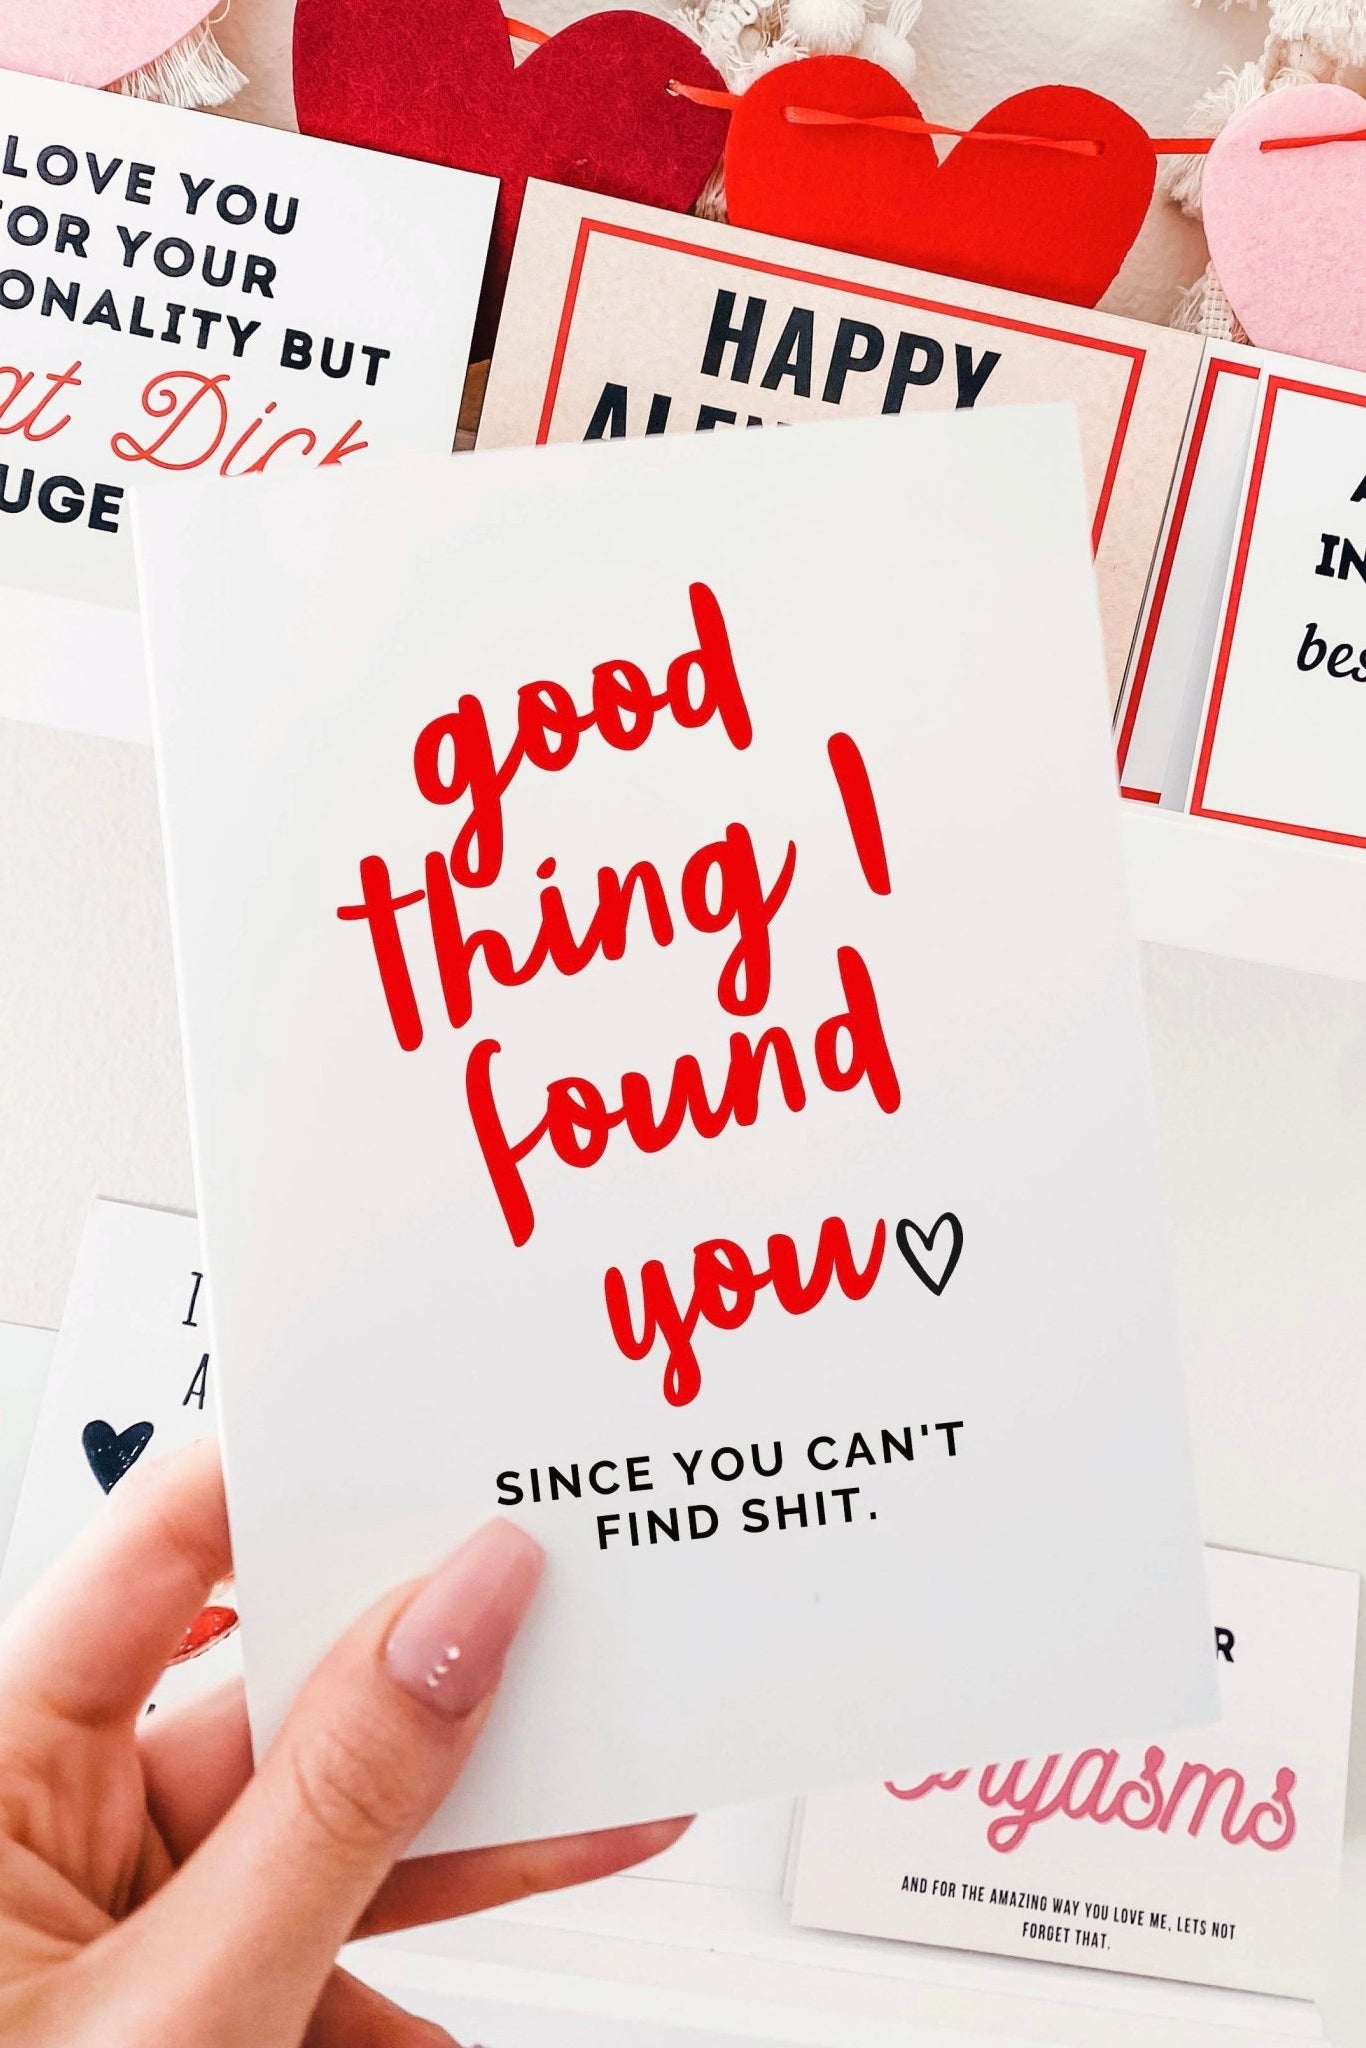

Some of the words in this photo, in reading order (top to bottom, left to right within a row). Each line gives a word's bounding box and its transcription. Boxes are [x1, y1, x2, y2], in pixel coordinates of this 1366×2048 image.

[2, 134, 156, 206] LOVE
[179, 172, 300, 235] YOU
[0, 199, 91, 259] OR
[116, 225, 277, 299] YOUR
[279, 327, 391, 387] BUT
[700, 288, 1002, 416] HAPPY
[412, 581, 754, 890] good
[335, 821, 797, 1053] thing
[826, 731, 892, 897] I
[464, 944, 902, 1249] found
[603, 1215, 887, 1408] you
[496, 1455, 655, 1506] SINCE
[672, 1440, 785, 1486] YOU
[807, 1420, 965, 1471] CAN'T
[596, 1504, 719, 1550] FIND
[741, 1486, 878, 1535] SHIT.
[901, 1875, 928, 1894] AND
[932, 1879, 956, 1899] FOR
[961, 1883, 985, 1903] THE
[989, 1888, 1048, 1912] AMAZING
[1052, 1897, 1080, 1917] WAY
[1085, 1902, 1109, 1921] YOU
[1113, 1906, 1145, 1927] LOVE
[1176, 1916, 1207, 1937] LETS
[1211, 1921, 1237, 1941] NOT
[1021, 1921, 1071, 1945] FORGET
